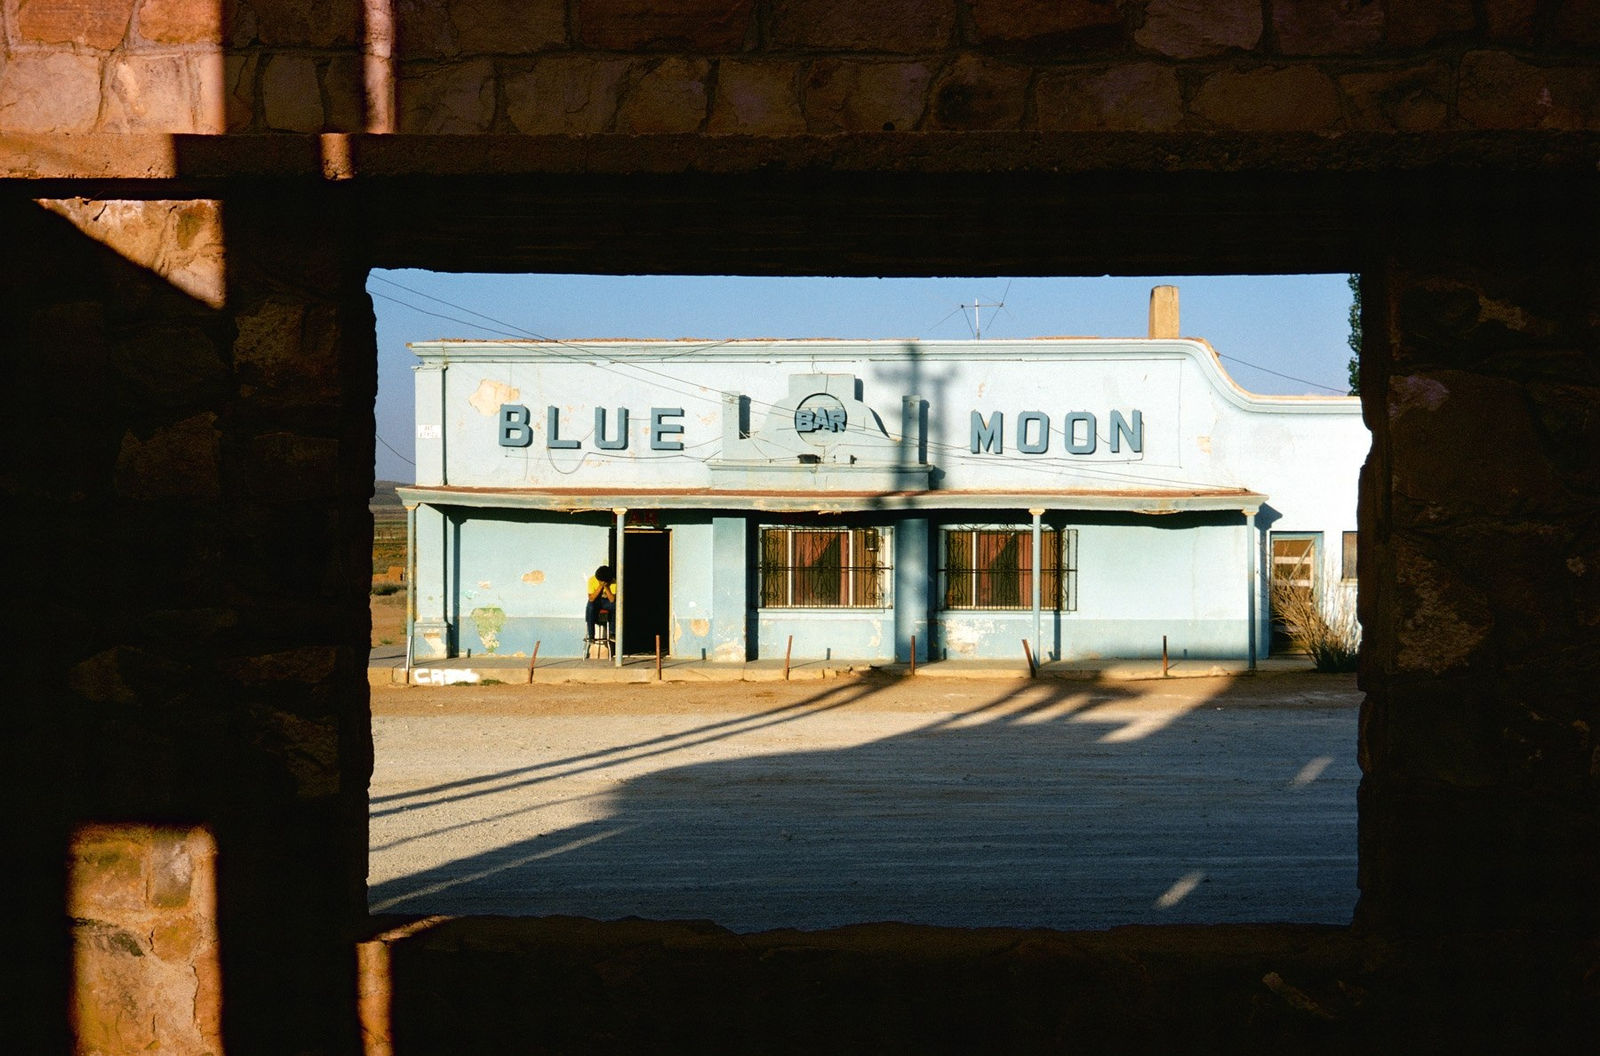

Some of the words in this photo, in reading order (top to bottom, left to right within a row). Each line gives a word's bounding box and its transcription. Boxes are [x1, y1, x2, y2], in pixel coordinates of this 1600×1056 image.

[499, 404, 684, 450] BLUE
[970, 409, 1142, 454] MOON
[796, 407, 847, 432] BAR
